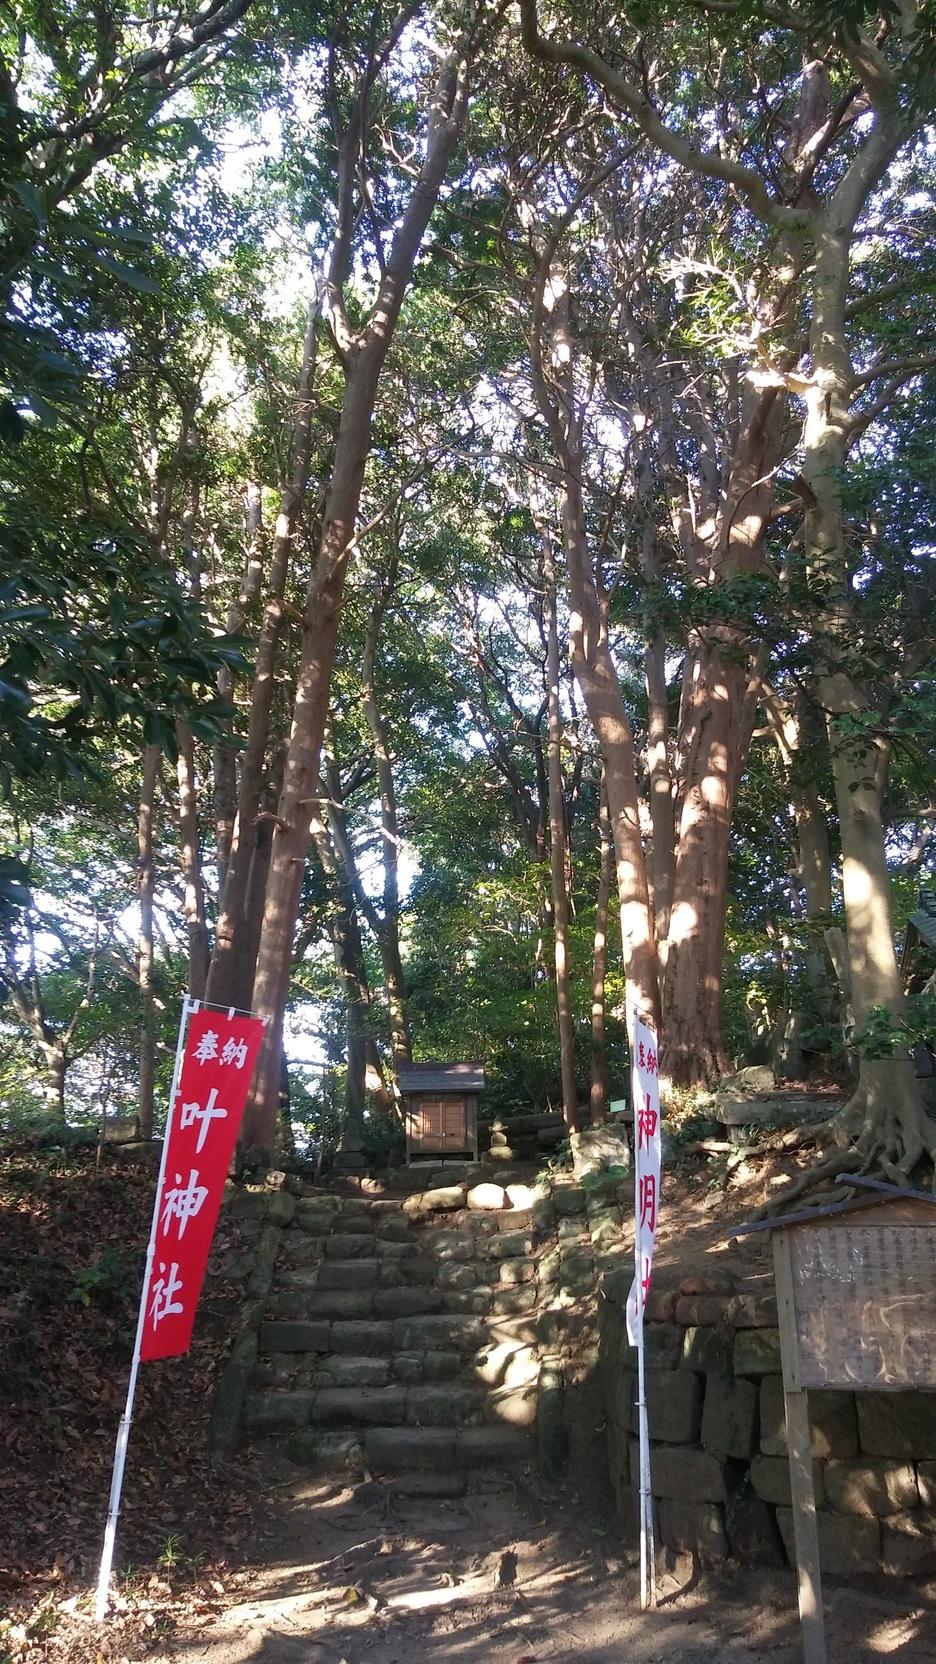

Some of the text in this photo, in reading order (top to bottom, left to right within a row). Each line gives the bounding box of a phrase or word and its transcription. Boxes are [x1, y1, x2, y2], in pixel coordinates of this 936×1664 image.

[191, 1029, 248, 1069] 奉納
[149, 1087, 228, 1332] 叶神社
